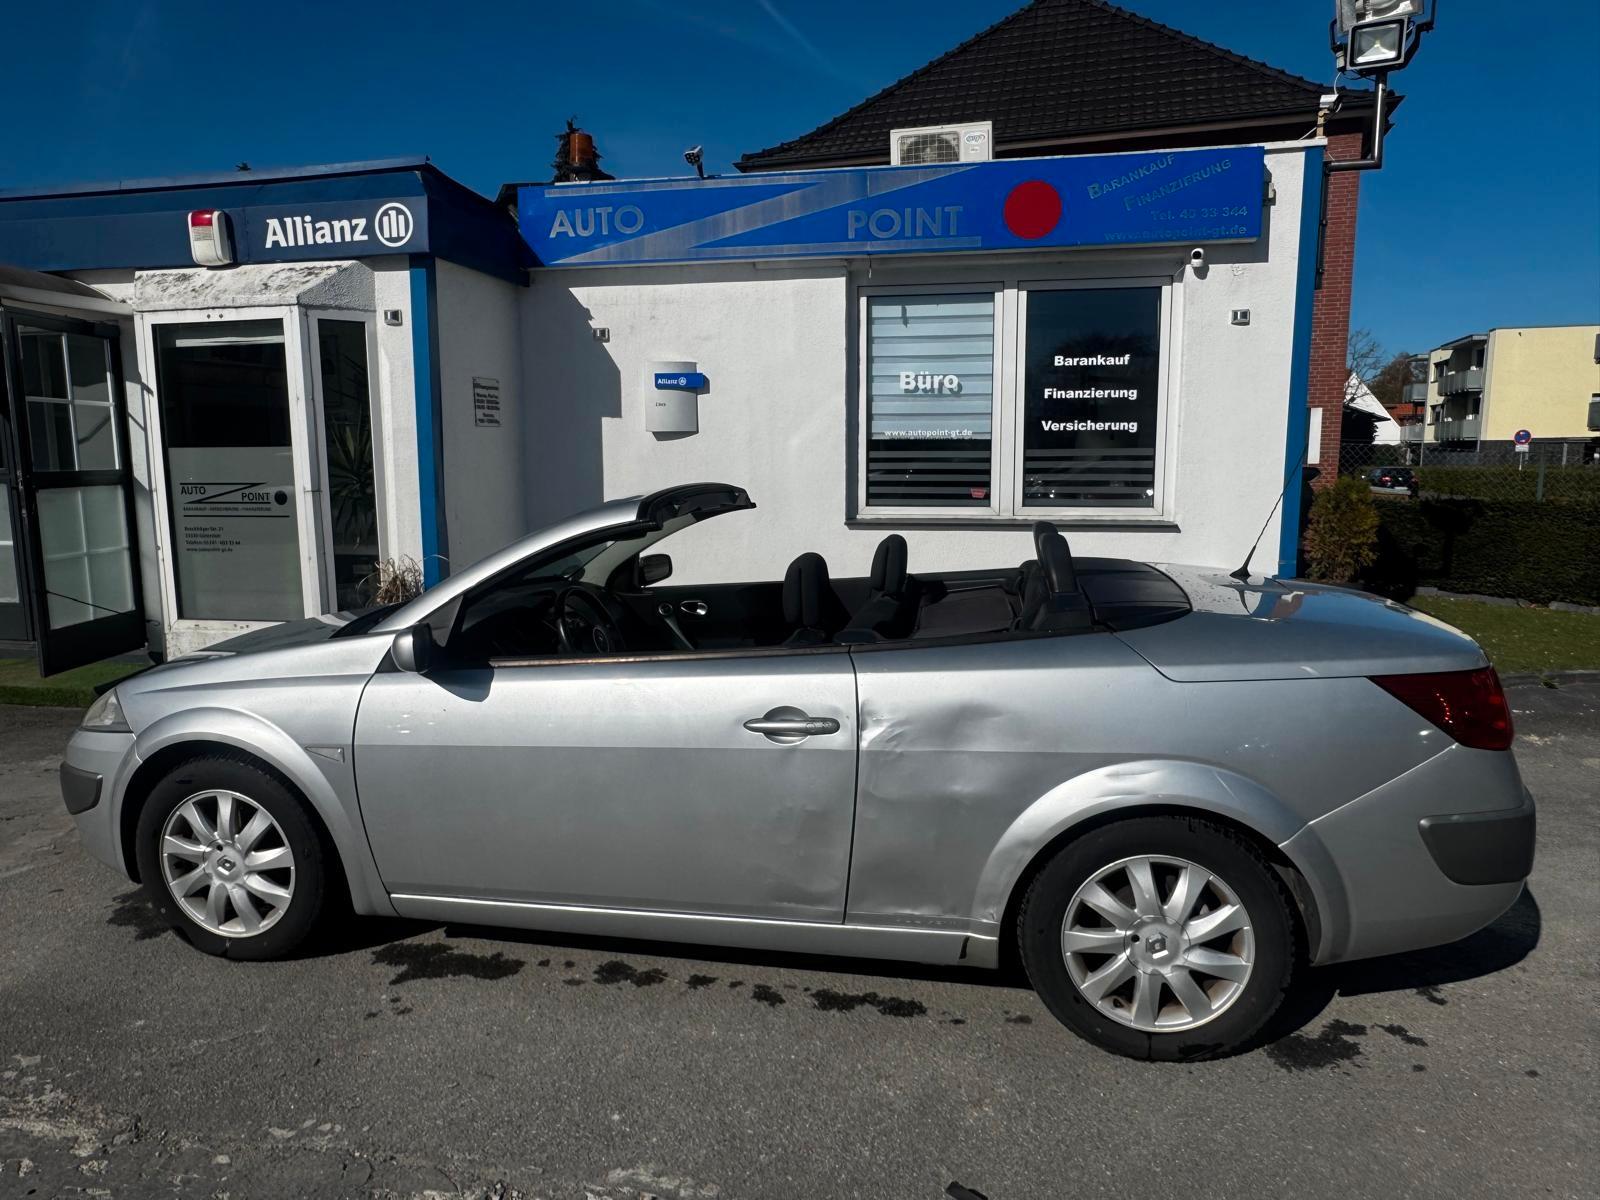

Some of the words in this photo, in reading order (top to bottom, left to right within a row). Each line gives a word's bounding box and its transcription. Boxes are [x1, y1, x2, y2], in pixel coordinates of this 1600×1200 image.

[1087, 154, 1175, 199] BARANKAUF
[1222, 205, 1248, 217] 344
[550, 205, 644, 239] AUTO
[847, 206, 963, 239] POINT
[265, 215, 368, 248] Allianz
[1054, 354, 1131, 366] Barankauf
[900, 371, 959, 390] Büro
[1044, 387, 1138, 400] Finanzierung
[1041, 420, 1138, 433] Versicherung
[884, 429, 973, 438] www.autopoint-gt.de
[180, 486, 206, 495] AUTO
[241, 492, 271, 502] POINT
